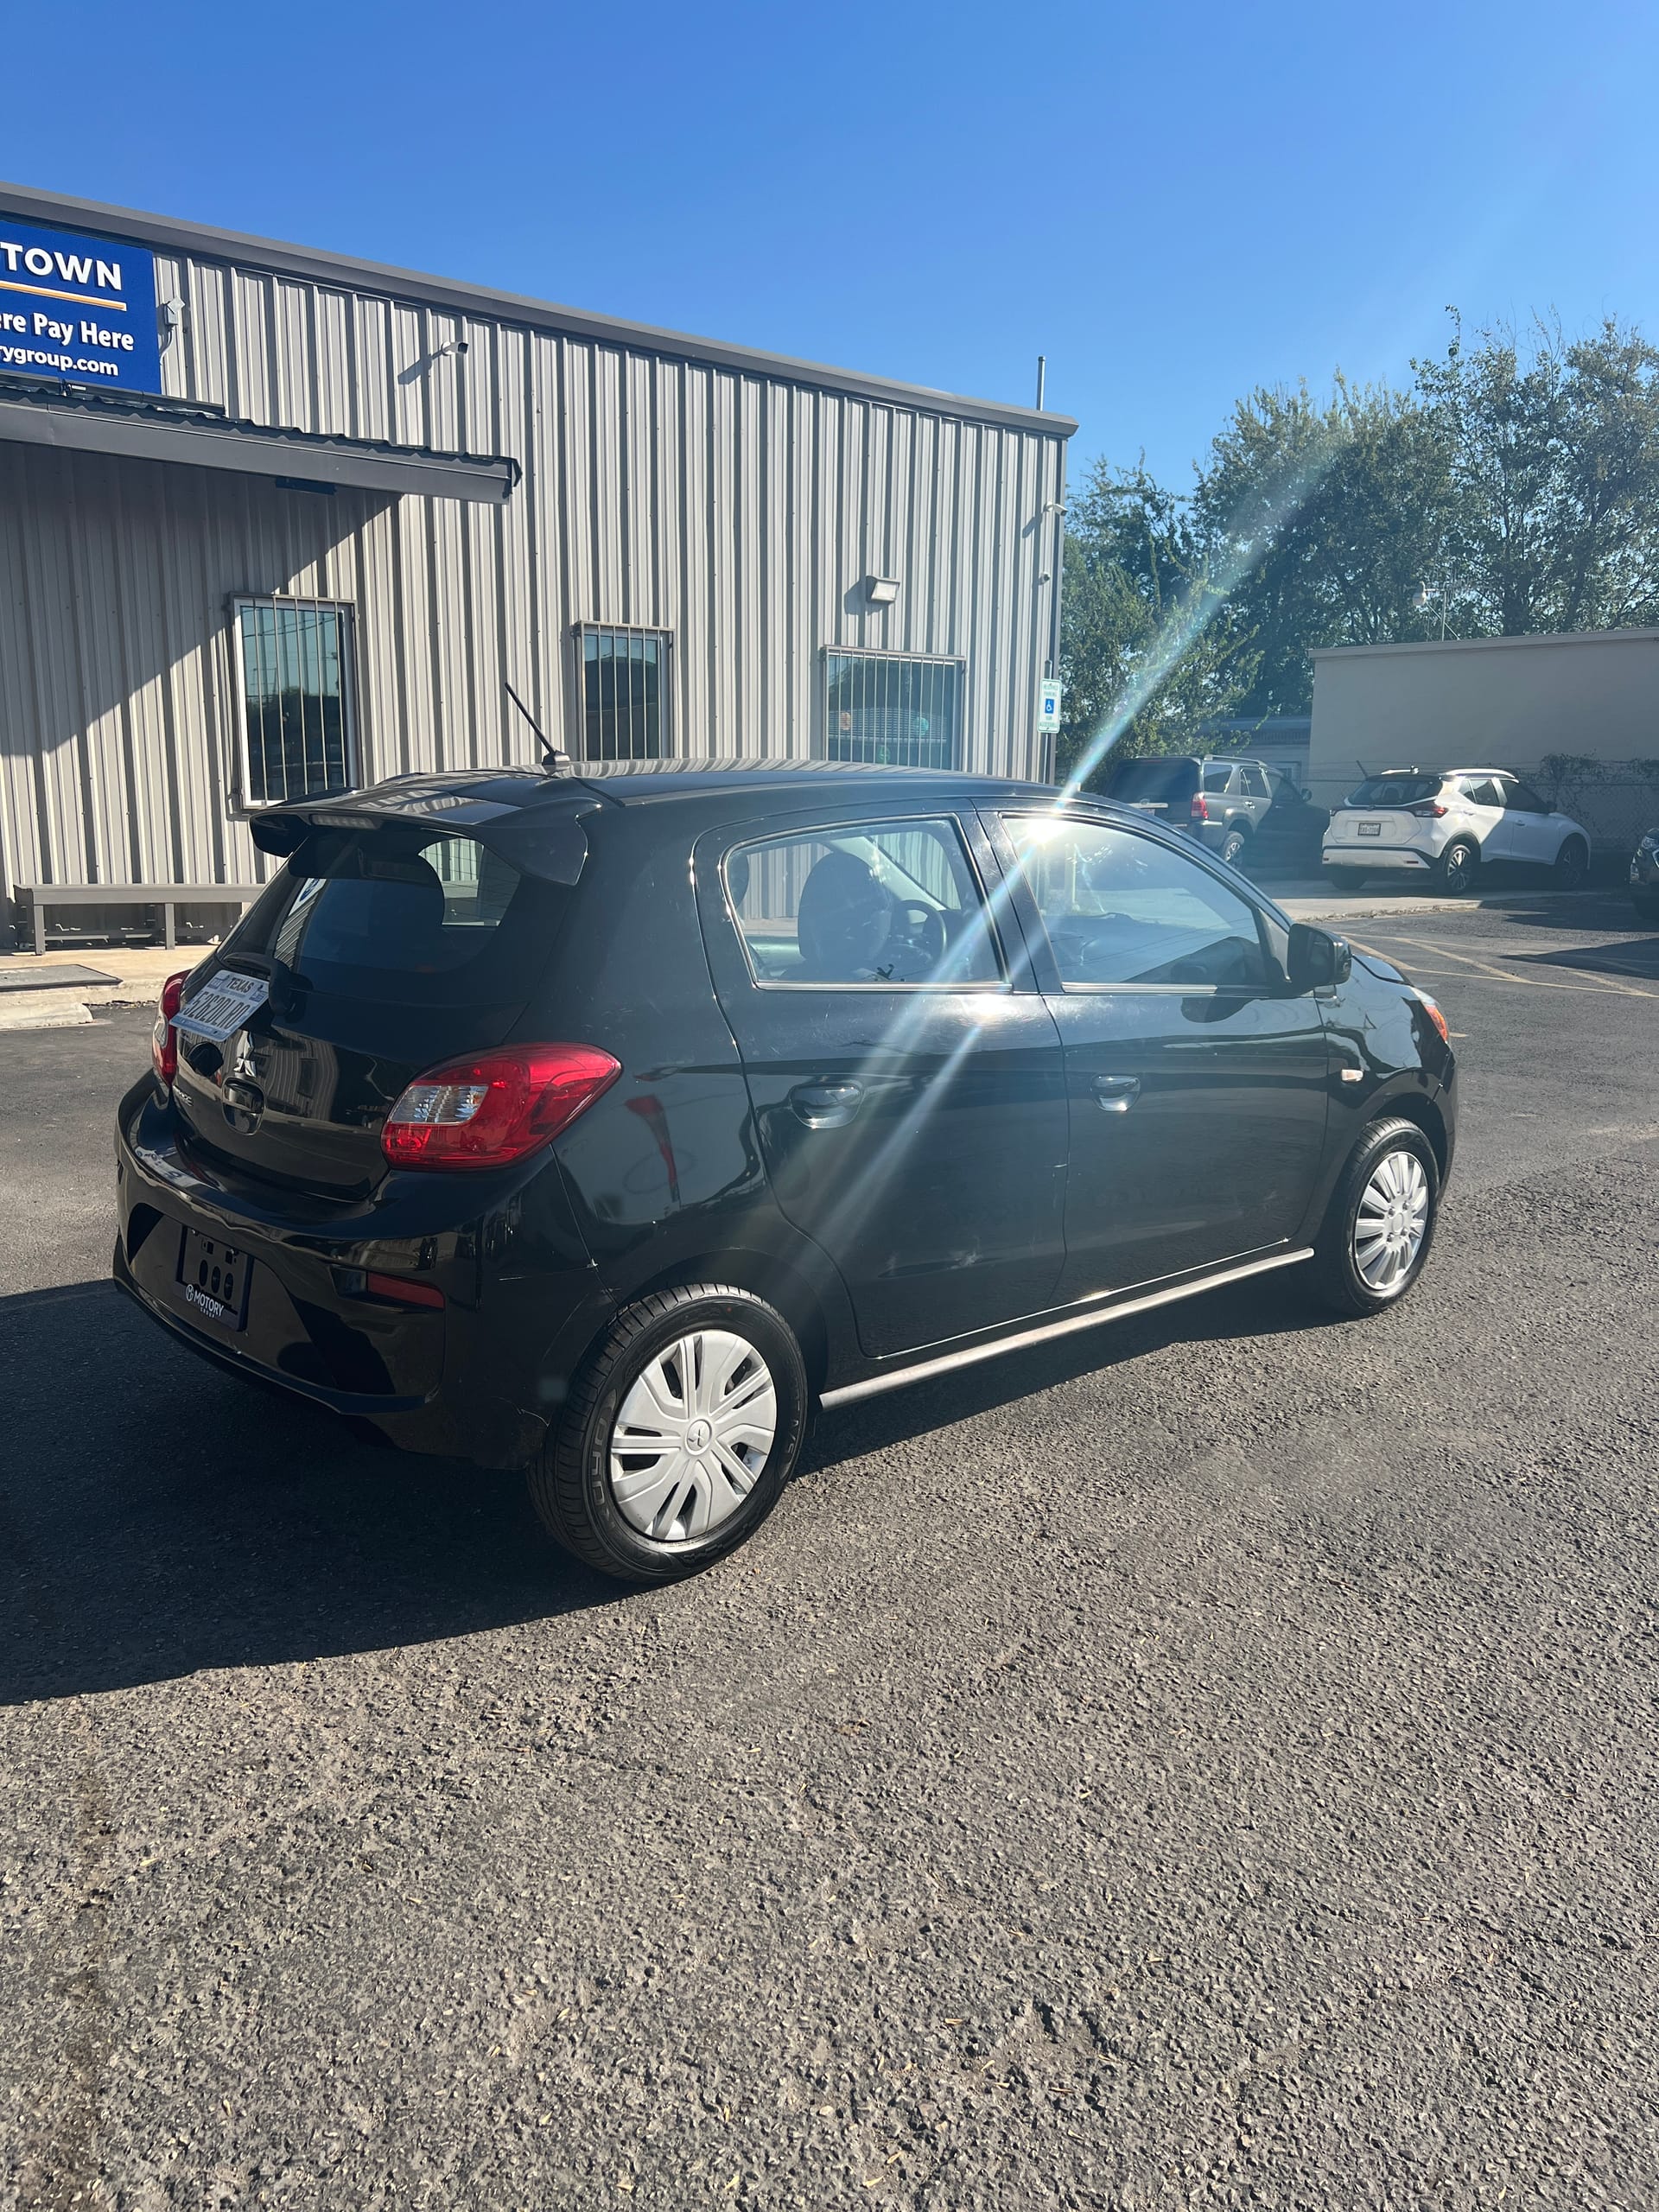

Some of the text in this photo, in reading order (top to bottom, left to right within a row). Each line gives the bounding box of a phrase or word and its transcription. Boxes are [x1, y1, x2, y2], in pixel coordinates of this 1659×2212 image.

[0, 242, 122, 290] TOWN
[0, 312, 134, 351] re Pay Here
[226, 977, 255, 994] TEXAS
[194, 1289, 225, 1318] MOTORY
